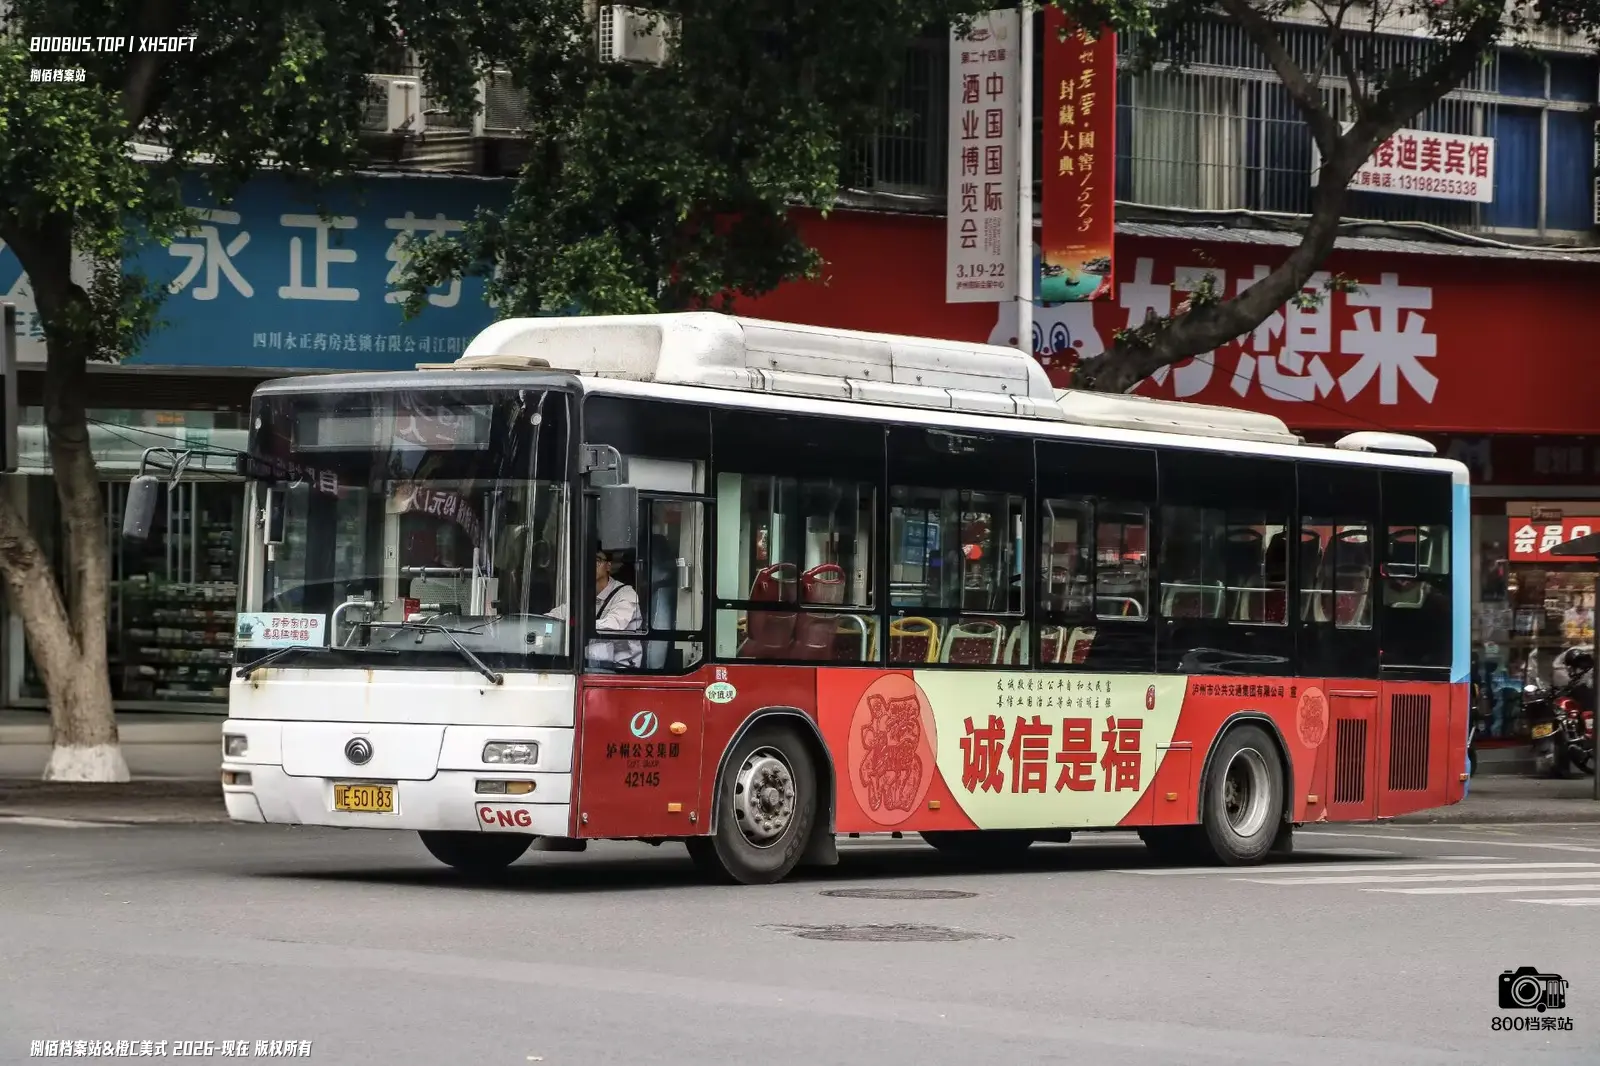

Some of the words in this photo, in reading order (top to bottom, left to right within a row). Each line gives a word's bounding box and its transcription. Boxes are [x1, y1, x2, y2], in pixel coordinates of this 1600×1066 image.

[960, 74, 981, 249] 酒业博览会
[984, 72, 1003, 212] 中国国际
[1059, 79, 1075, 176] 封藏大典
[168, 206, 505, 308] 永正药
[956, 263, 1005, 278] 3.19-22
[624, 772, 660, 788] 42145
[960, 714, 1143, 794] 诚信是福
[480, 806, 532, 828] CNG
